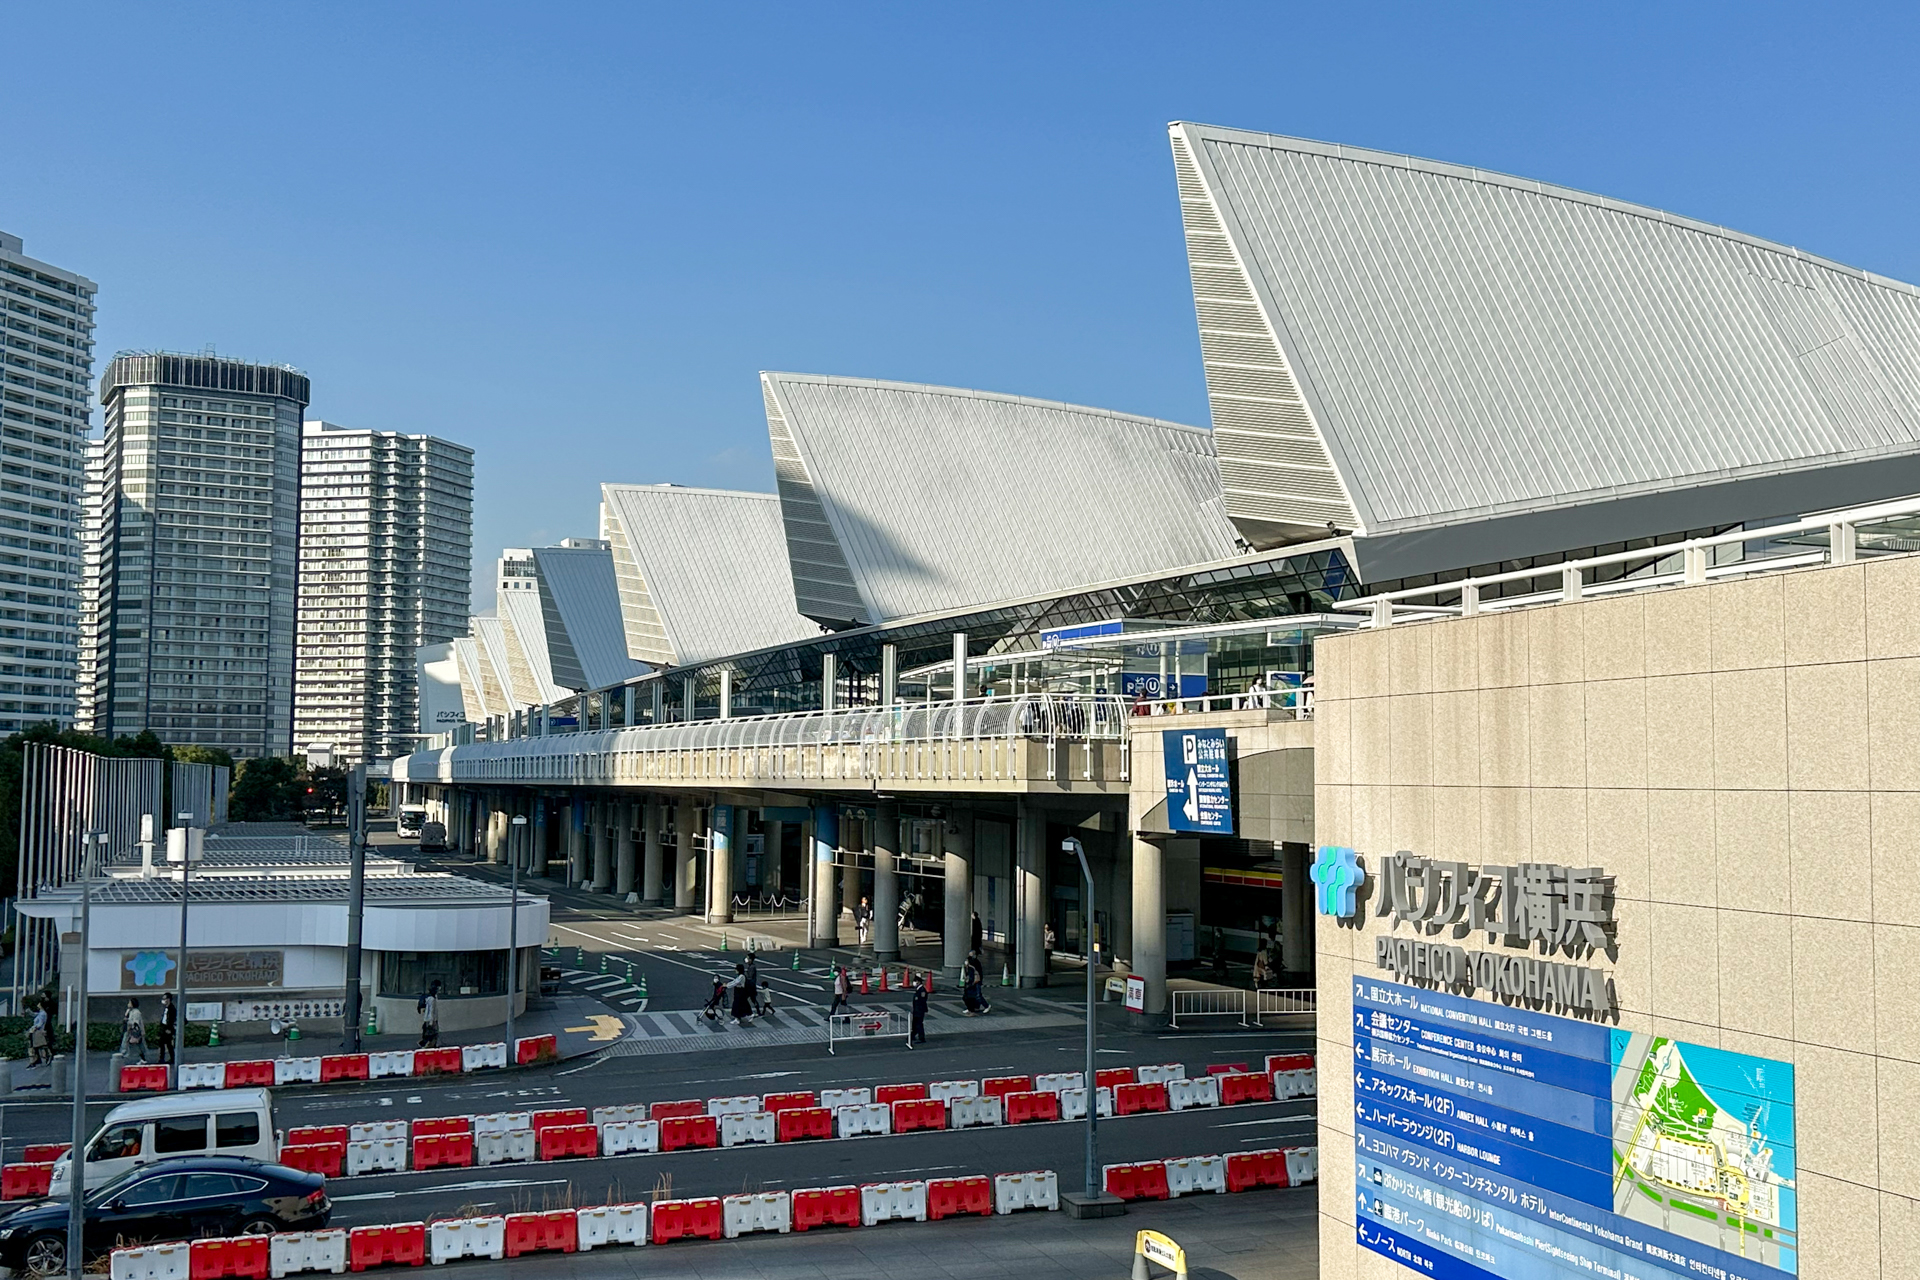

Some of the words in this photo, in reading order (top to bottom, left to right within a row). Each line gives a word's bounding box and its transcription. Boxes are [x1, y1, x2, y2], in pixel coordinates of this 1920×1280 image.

[1127, 682, 1135, 693] P
[1186, 738, 1194, 761] P
[1376, 851, 1608, 948] パシフィコ横浜
[1376, 936, 1461, 984] PACIFICO
[1468, 950, 1609, 1011] YOKOHAMA
[1370, 986, 1419, 1010] 国立大ホール
[1421, 1003, 1445, 1018] NATIONAL
[1446, 1009, 1478, 1025] CONVENTION
[1479, 1016, 1493, 1029] HALL
[1371, 1010, 1420, 1034] 会議センター
[1421, 1030, 1453, 1047] CONFERENCE
[1454, 1038, 1475, 1052] CENTER
[1371, 1045, 1412, 1072] 展示ホール
[1413, 1064, 1440, 1081] EXHIBITION
[1441, 1072, 1454, 1085] HALL
[1371, 1077, 1455, 1117] アネックスホール(2F)
[1457, 1109, 1475, 1123] ANNEX
[1475, 1115, 1489, 1128] HALL
[1372, 1107, 1456, 1150] ハーバーラウンジ(2F)
[1456, 1142, 1478, 1159] HARBOR
[1479, 1149, 1501, 1166] LOUNGE
[1372, 1138, 1400, 1161] ヨコハマ
[1401, 1148, 1430, 1172] グランド
[1432, 1161, 1518, 1205] インターコンチネンタル
[1520, 1192, 1548, 1216] ホテル
[1594, 1225, 1624, 1245] Yokohama
[1625, 1235, 1643, 1252] Grand
[1383, 1202, 1425, 1233] 臨港パーク
[1383, 1171, 1495, 1231] ぷかりさん橋(観光船のりば)
[1579, 1255, 1593, 1271] Ship
[1374, 1232, 1396, 1253] ノース
